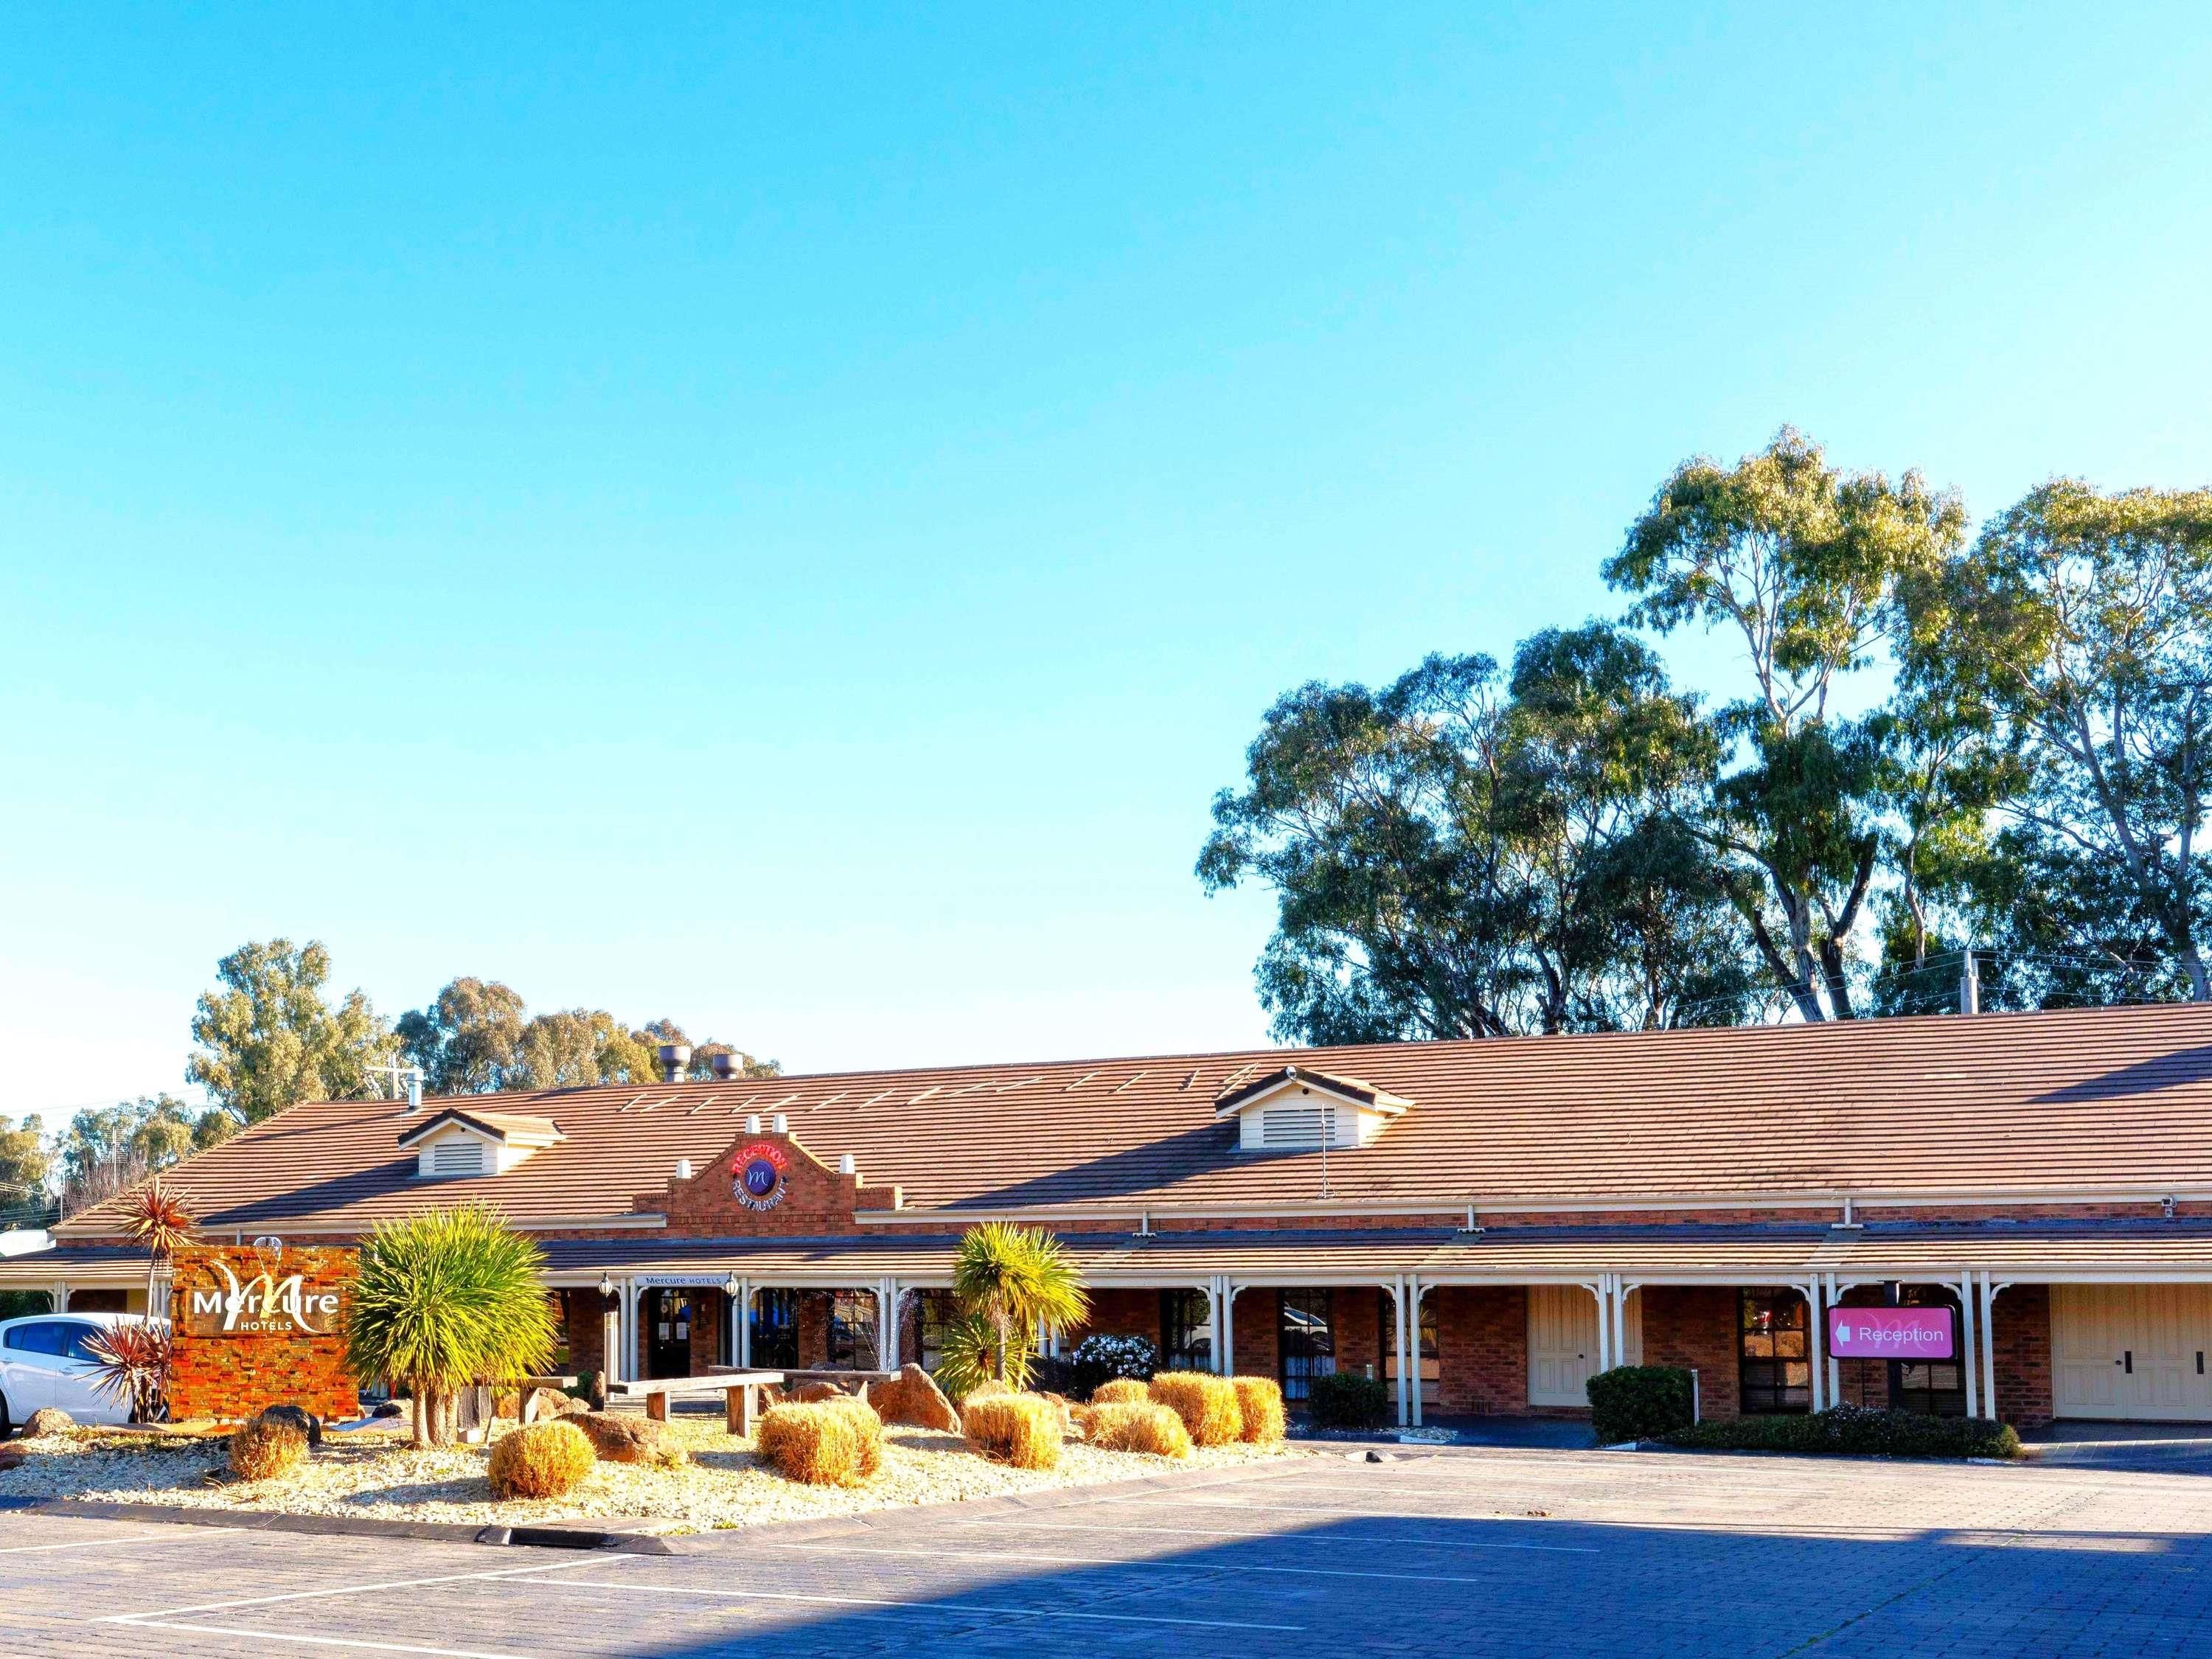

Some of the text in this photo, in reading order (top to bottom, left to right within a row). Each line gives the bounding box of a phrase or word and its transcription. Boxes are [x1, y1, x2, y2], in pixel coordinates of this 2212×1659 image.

[732, 1178, 788, 1211] RESTAURANT
[646, 1277, 686, 1285] Mercure
[193, 1291, 338, 1315] Mercure
[240, 1321, 293, 1332] HOTELS
[1859, 1327, 1944, 1344] Reception
